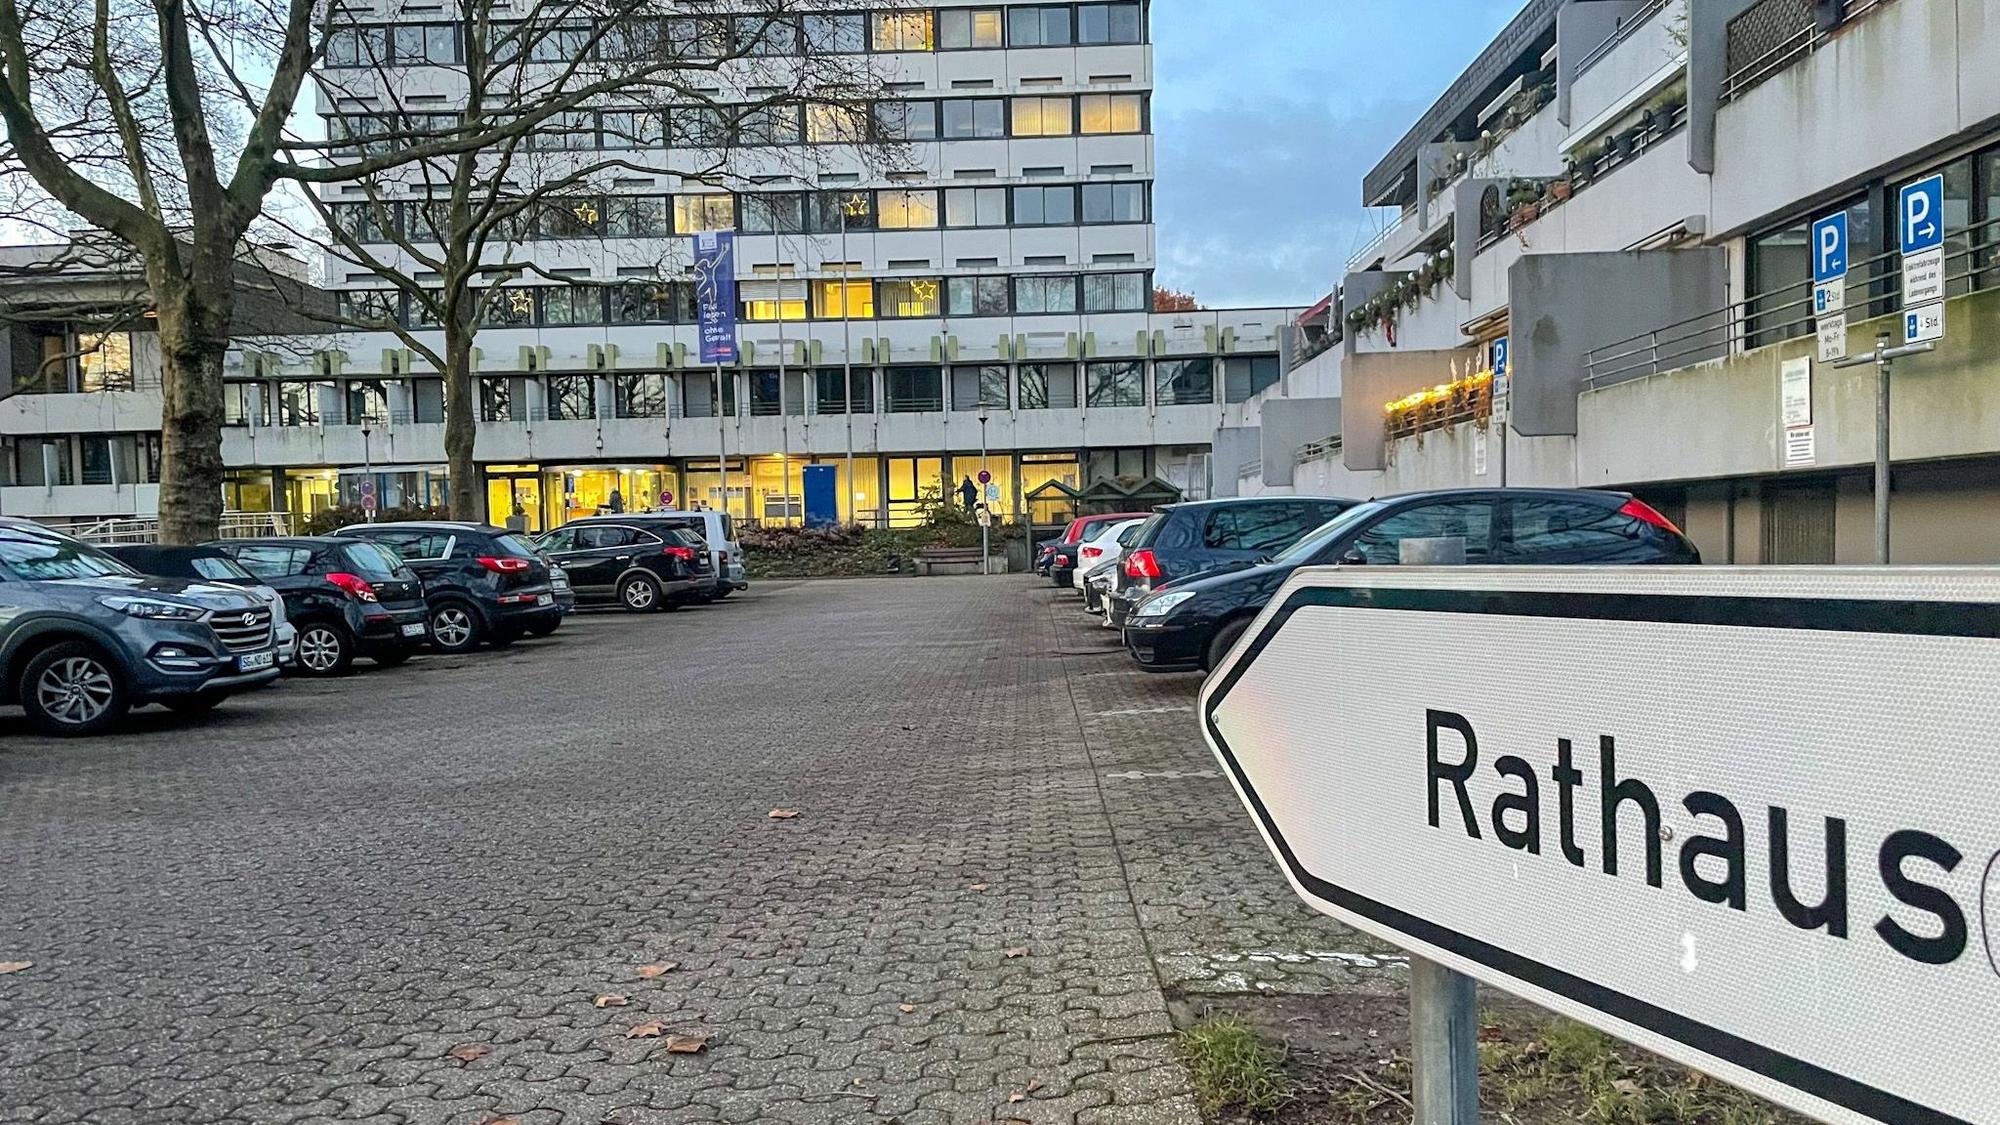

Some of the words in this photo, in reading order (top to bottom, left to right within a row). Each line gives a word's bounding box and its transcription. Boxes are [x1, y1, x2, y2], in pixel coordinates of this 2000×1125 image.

[1907, 191, 1930, 244] P
[1821, 225, 1839, 273] P
[1826, 290, 1832, 303] 2
[704, 327, 724, 335] ohne
[1496, 344, 1503, 371] P
[1425, 708, 1968, 965] Rathaus
